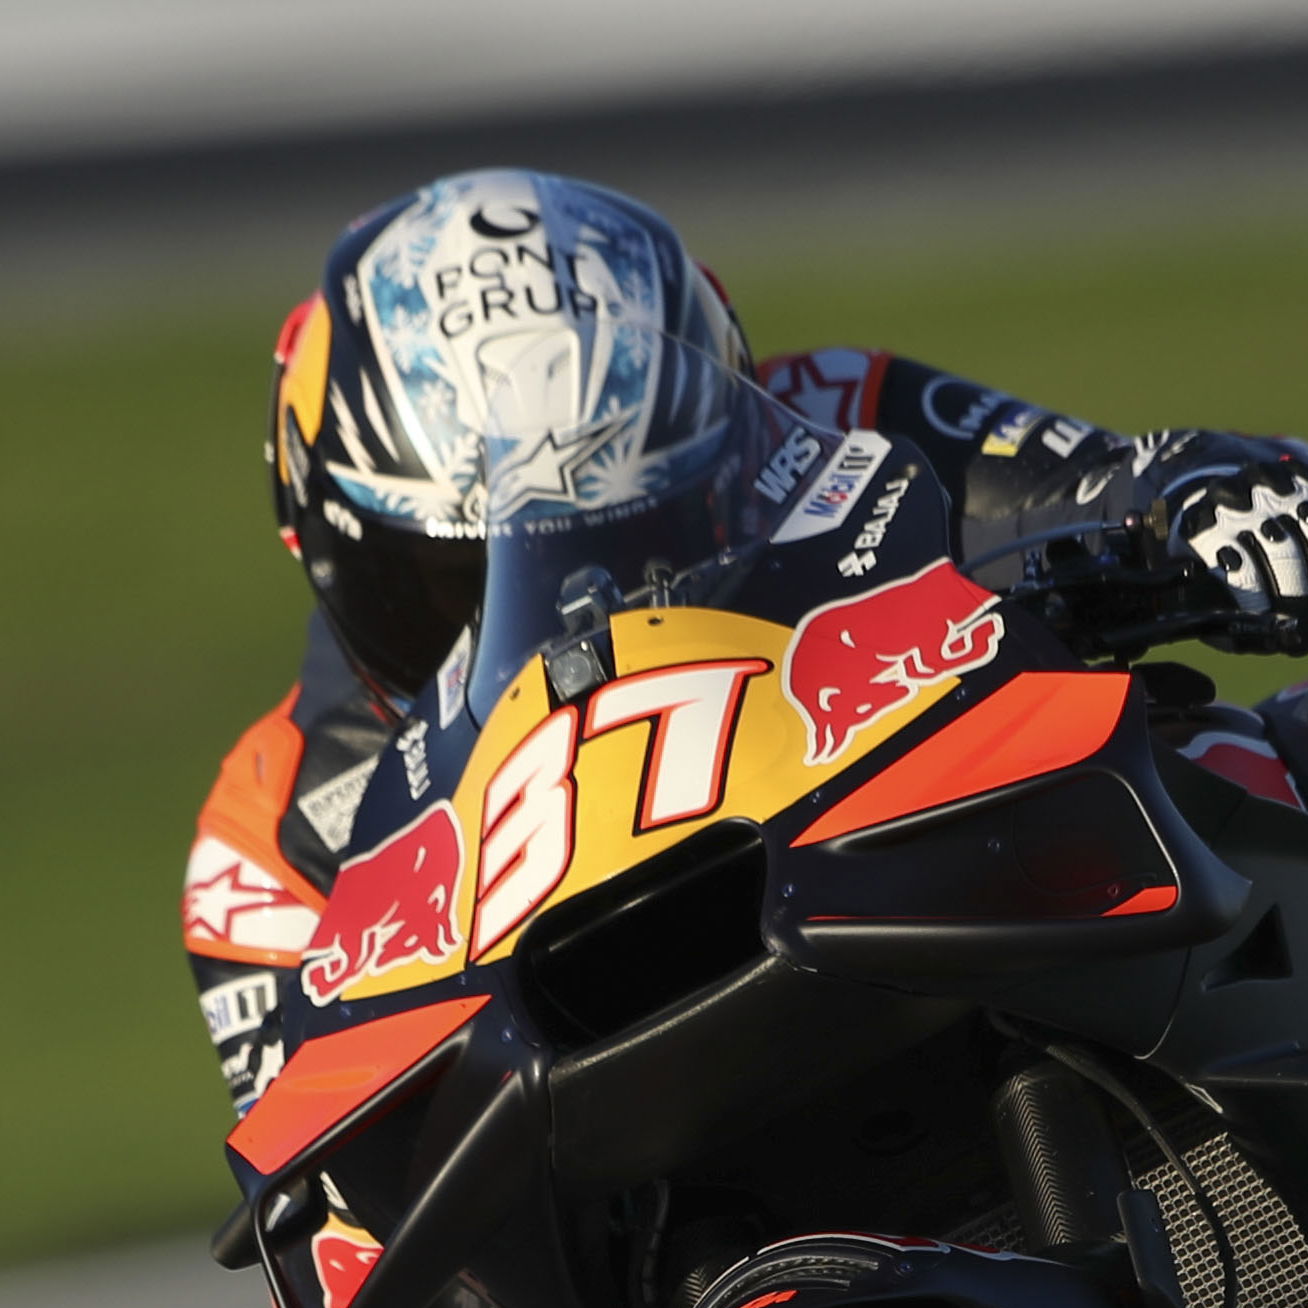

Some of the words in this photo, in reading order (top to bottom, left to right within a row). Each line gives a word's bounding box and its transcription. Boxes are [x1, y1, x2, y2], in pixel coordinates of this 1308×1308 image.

[439, 282, 599, 338] GRUP
[753, 426, 822, 505] WRS
[853, 477, 910, 550] BAJAJ
[468, 657, 774, 966] 37
